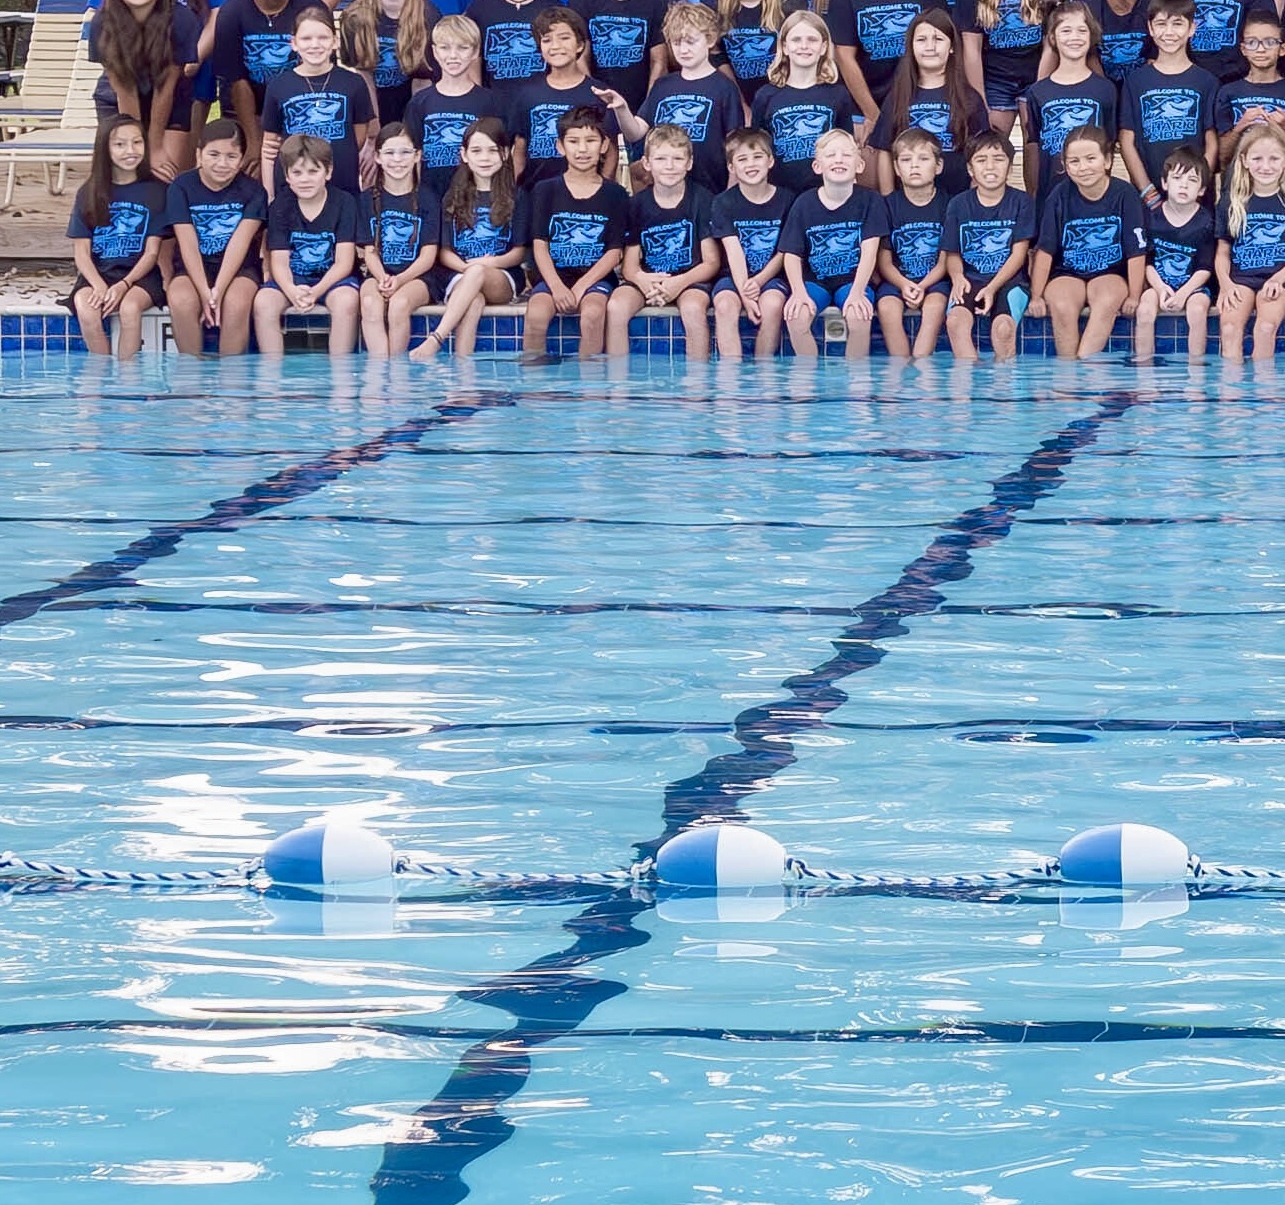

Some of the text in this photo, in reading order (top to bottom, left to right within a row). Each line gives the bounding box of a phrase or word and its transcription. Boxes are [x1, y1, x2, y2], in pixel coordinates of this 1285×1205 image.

[865, 3, 912, 13] WELCOME TO
[495, 23, 530, 31] WELCOME
[1147, 88, 1182, 96] WELCOME
[1238, 96, 1285, 106] WELCOME TO
[779, 104, 827, 114] WELCOME TO
[428, 112, 475, 121] WELCOME TO
[594, 214, 604, 222] TO
[1073, 217, 1105, 225] WELCOME
[1065, 248, 1121, 266] SHARK
